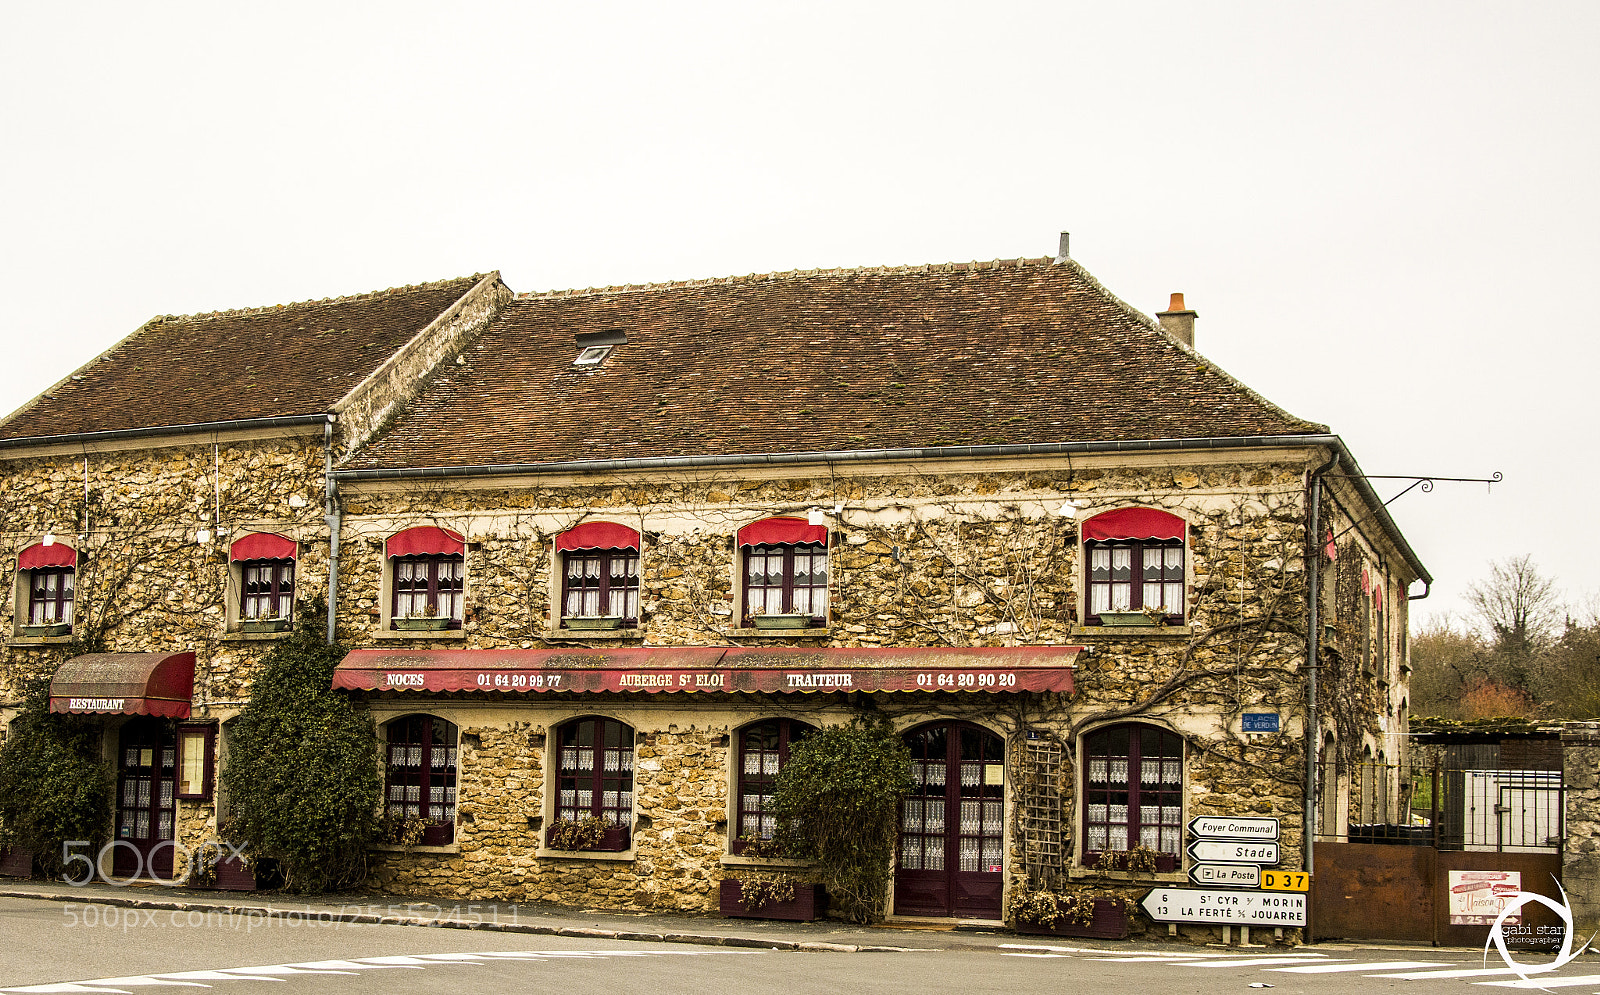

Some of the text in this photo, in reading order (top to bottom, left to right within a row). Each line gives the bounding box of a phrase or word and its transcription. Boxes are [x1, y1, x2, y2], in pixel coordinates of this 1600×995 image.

[386, 673, 425, 686] NOCES
[477, 674, 562, 687] 01 64 20 99 77
[619, 674, 673, 687] AUBERGE
[696, 674, 725, 687] ELOI
[787, 673, 852, 687] TRAITEUR
[917, 674, 1016, 686] 01 64 20 90 20
[69, 699, 125, 709] RESTAURANT
[1202, 823, 1274, 834] Foyer Communal
[1235, 847, 1273, 858] Stade
[1216, 870, 1255, 880] La Poste
[1265, 874, 1275, 886] D
[1162, 894, 1168, 903] 6
[1217, 896, 1239, 906] CYR
[1262, 898, 1303, 908] MORIN
[1157, 906, 1168, 915] 13
[1181, 907, 1194, 917] LA
[1199, 907, 1232, 918] FERTÉ
[1251, 910, 1303, 921] JOUARRE
[1454, 916, 1463, 924] A
[1466, 916, 1483, 924] 25
